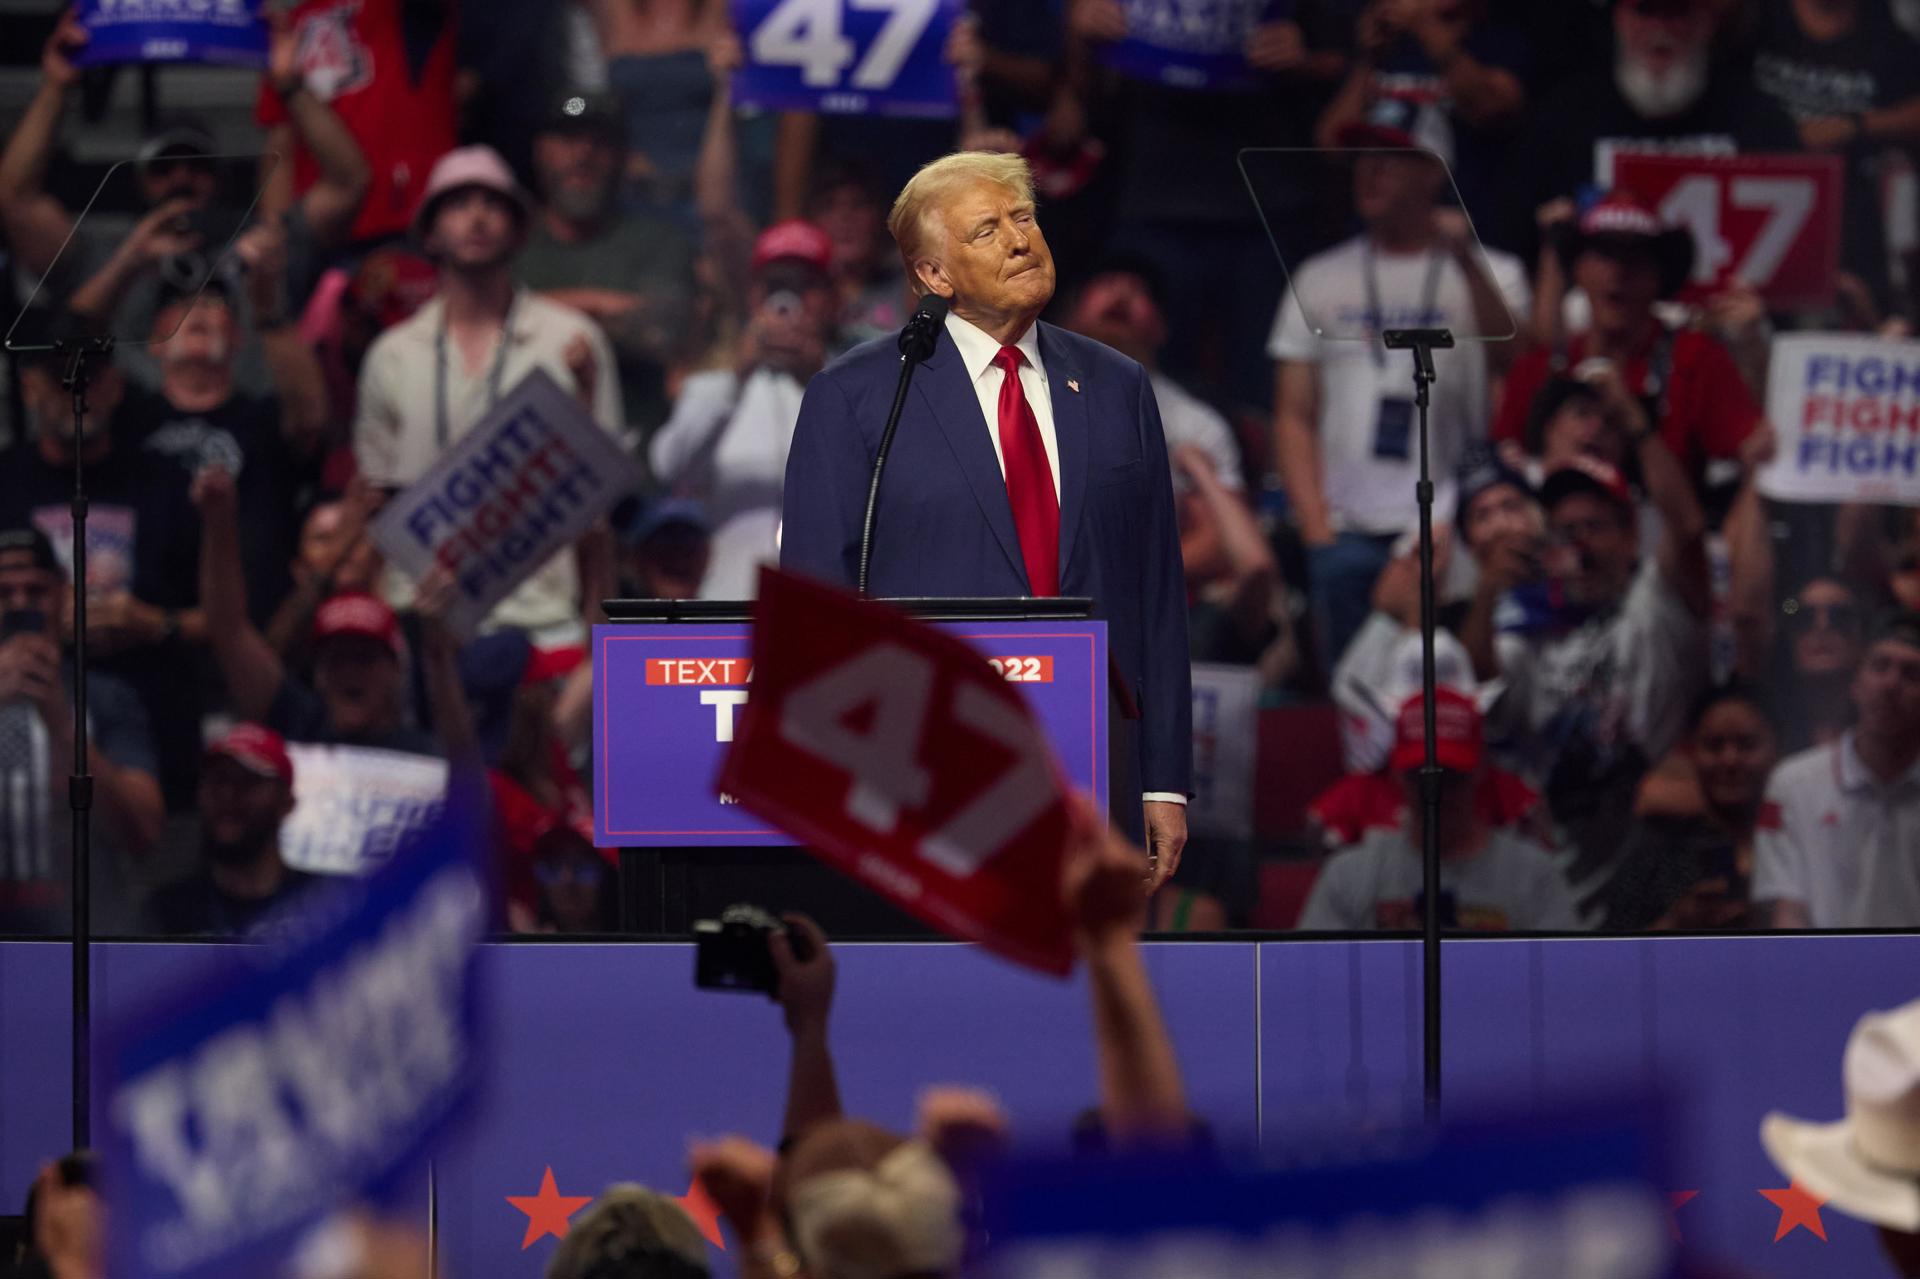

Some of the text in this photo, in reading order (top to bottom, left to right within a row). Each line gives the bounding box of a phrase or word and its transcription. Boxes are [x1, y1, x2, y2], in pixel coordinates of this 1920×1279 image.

[752, 0, 940, 88] 47
[1657, 172, 1818, 286] 47
[408, 403, 548, 547] FIGHT!
[658, 660, 736, 684] TEXT
[778, 640, 1063, 880] 47
